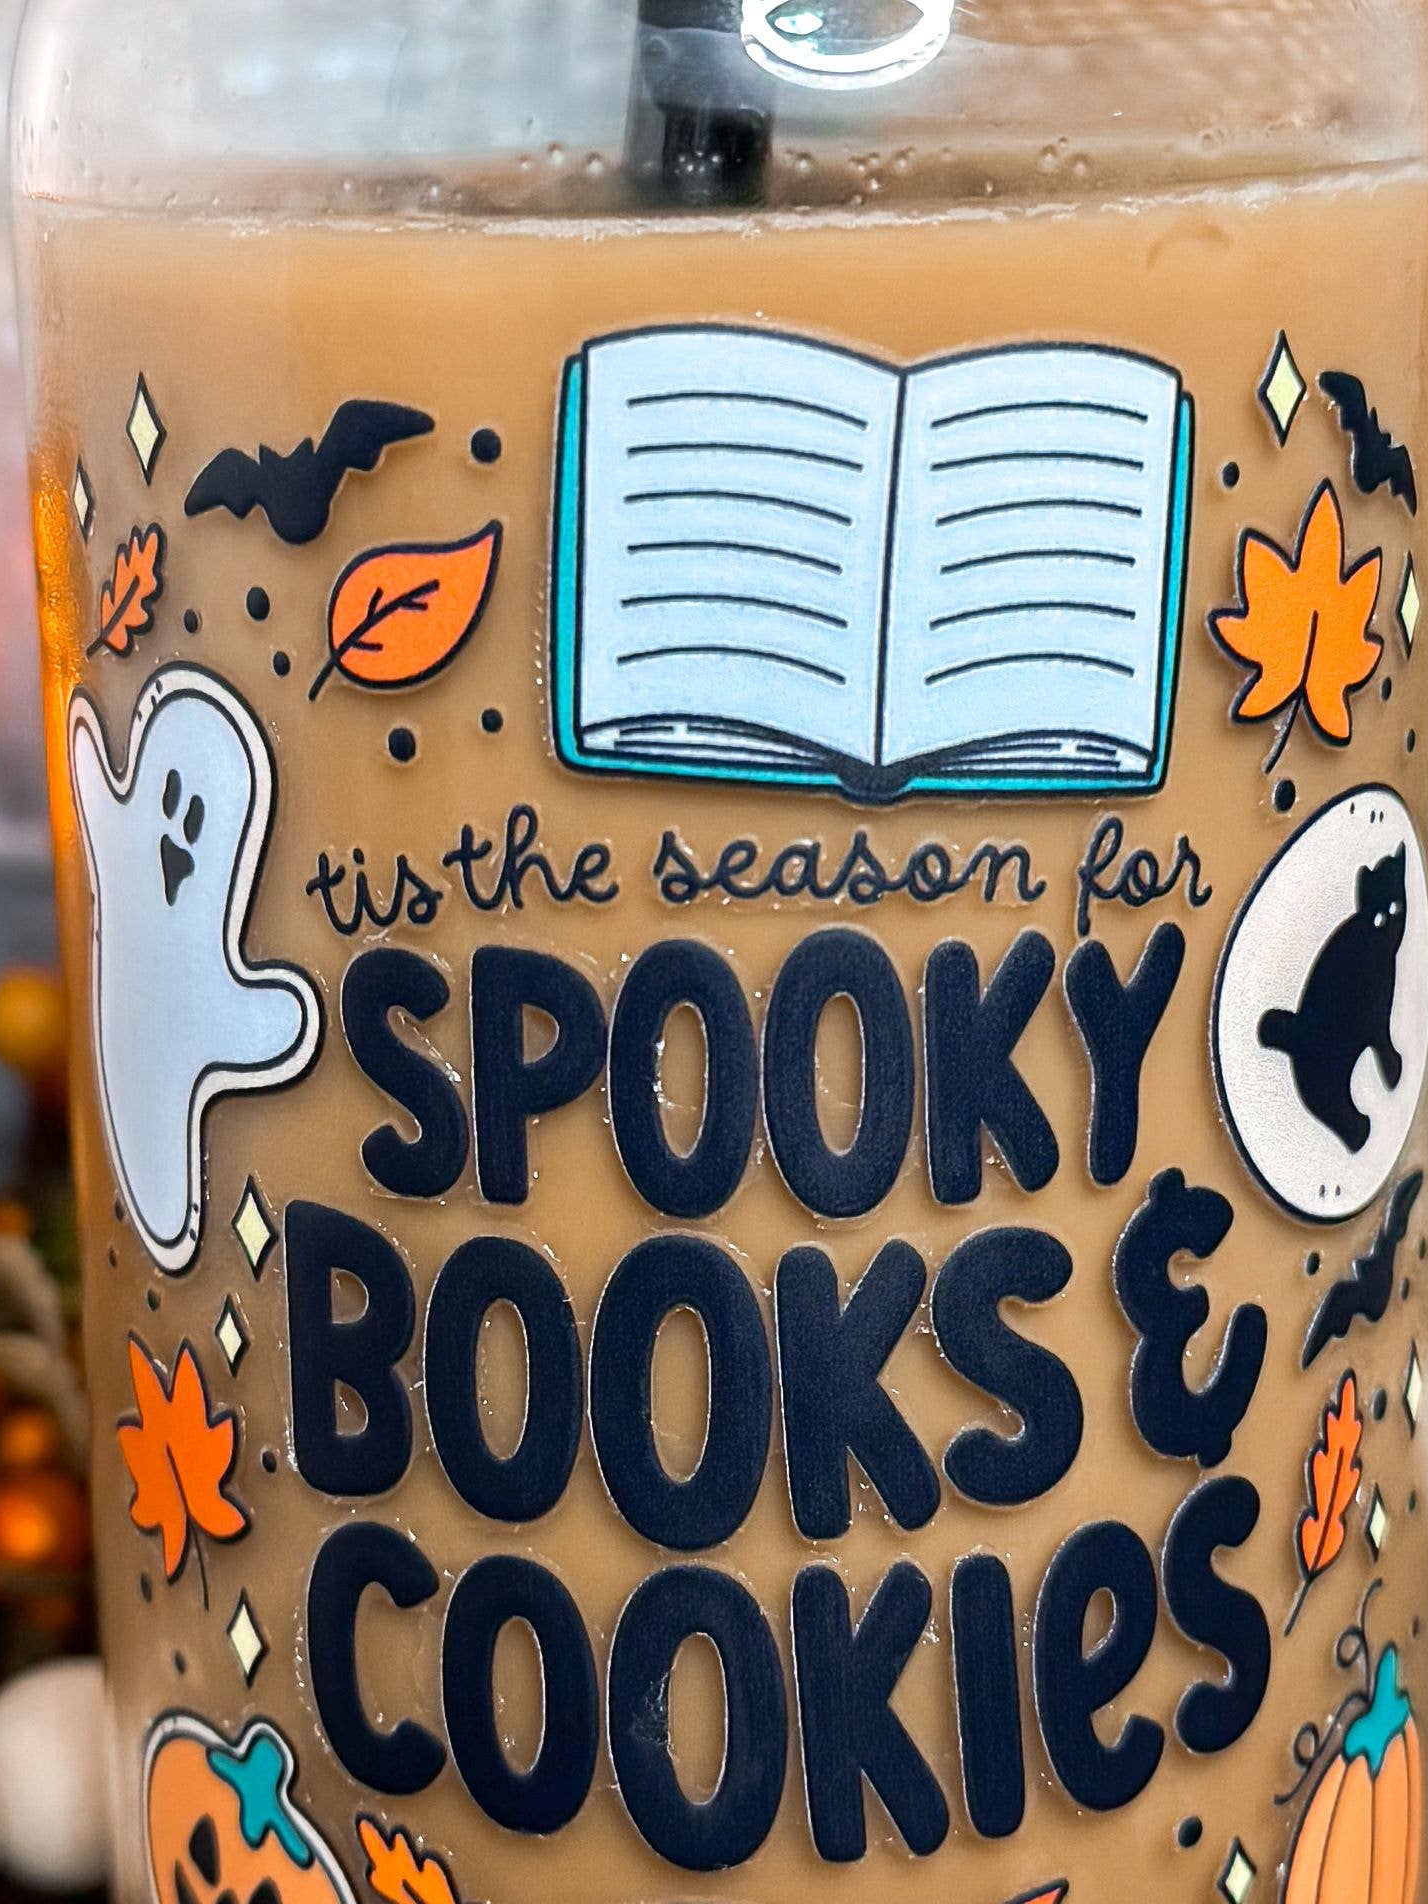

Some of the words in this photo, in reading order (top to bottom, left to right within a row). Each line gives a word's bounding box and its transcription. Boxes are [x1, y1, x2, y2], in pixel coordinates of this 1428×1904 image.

[305, 847, 444, 937] tis
[442, 804, 620, 912] the
[652, 830, 1047, 906] season
[1076, 816, 1213, 937] for
[340, 924, 1186, 1220] SPOOKY
[283, 1198, 1086, 1554] BOOKS
[1113, 1166, 1269, 1470] &
